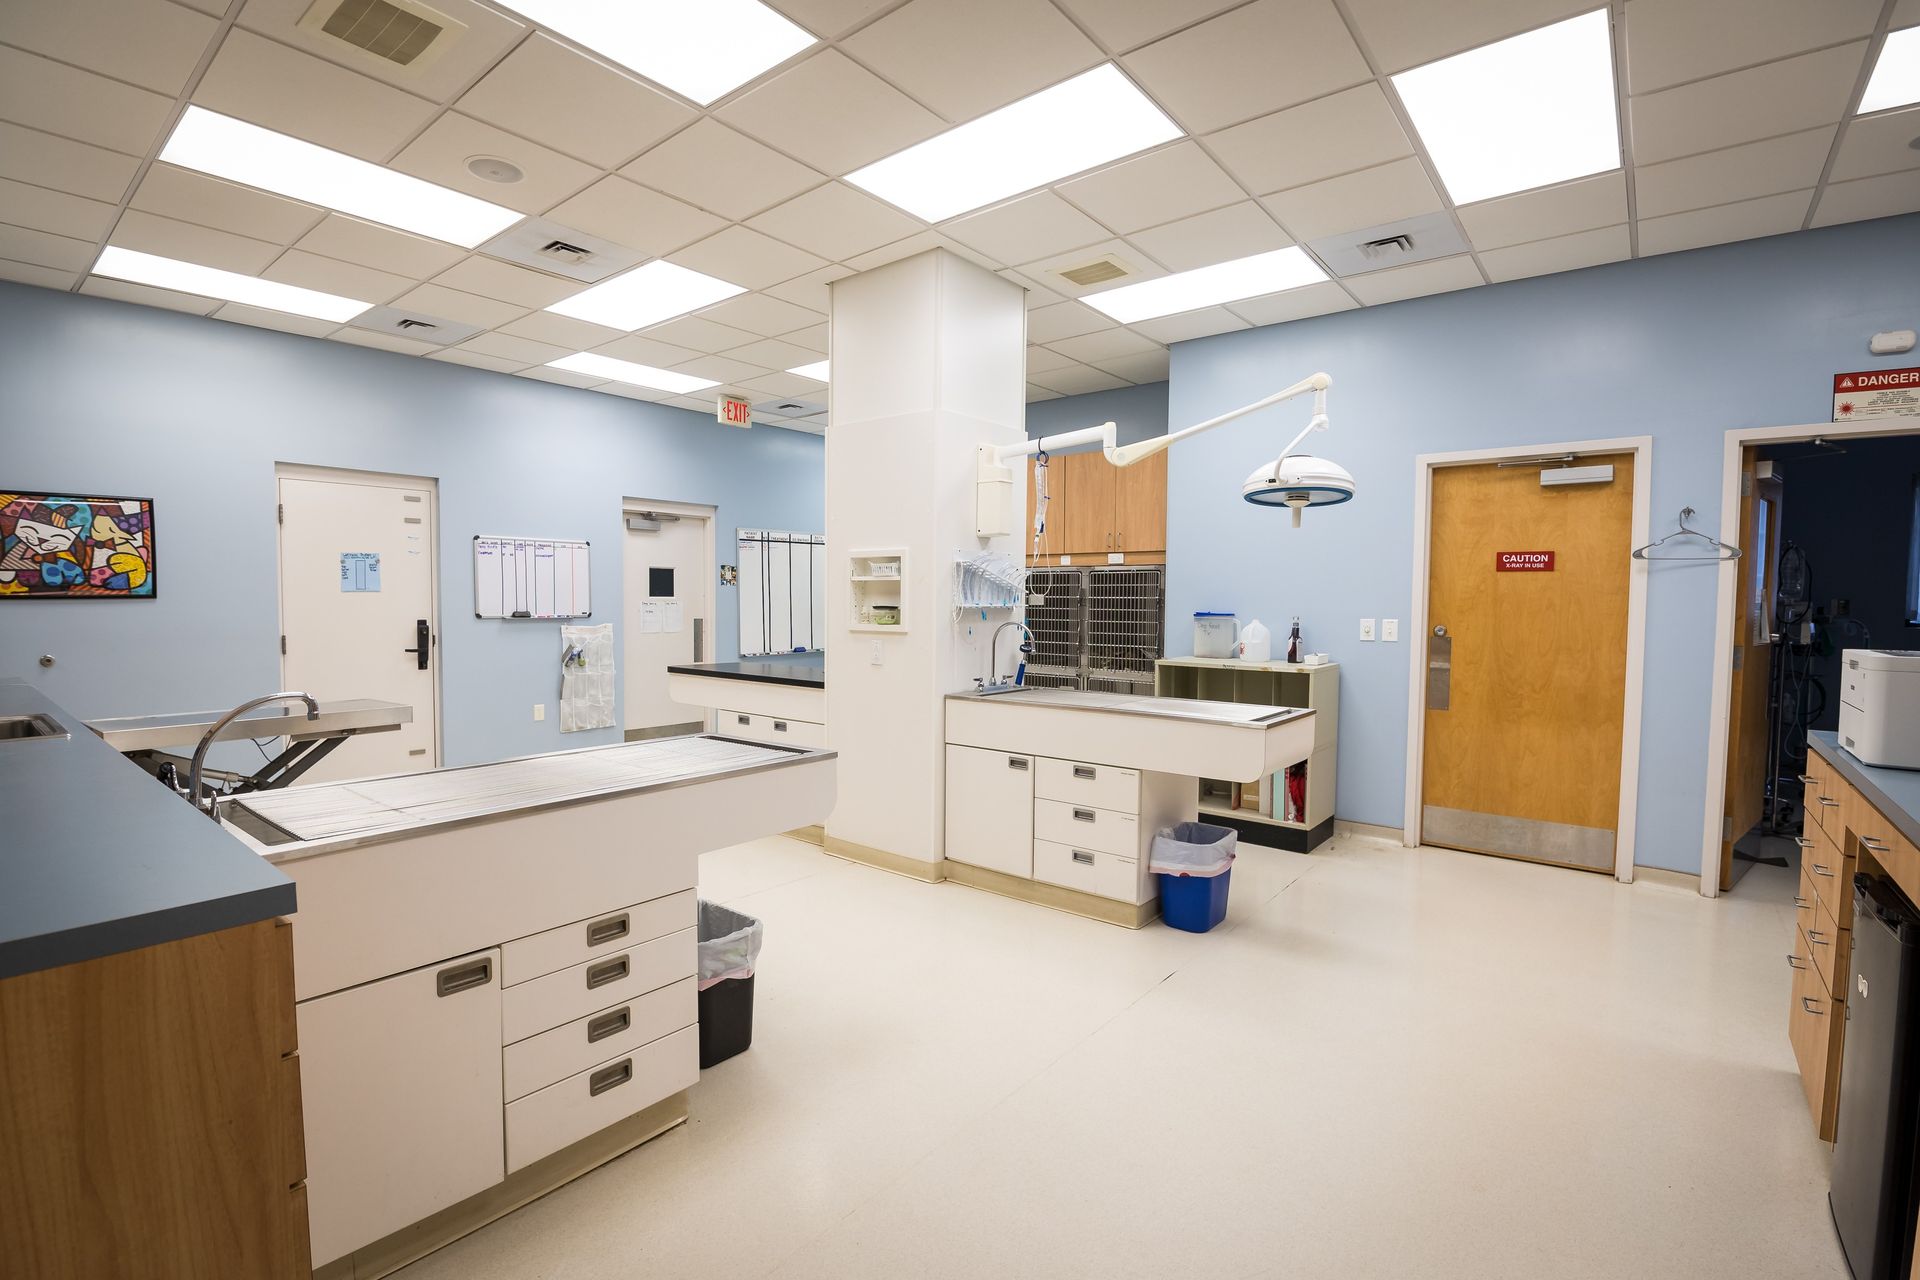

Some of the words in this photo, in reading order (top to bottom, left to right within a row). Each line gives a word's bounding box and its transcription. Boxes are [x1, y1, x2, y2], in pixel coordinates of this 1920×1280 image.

[1858, 372, 1919, 387] DANGER
[727, 400, 747, 423] EXIT
[1502, 554, 1549, 562] CAUTION
